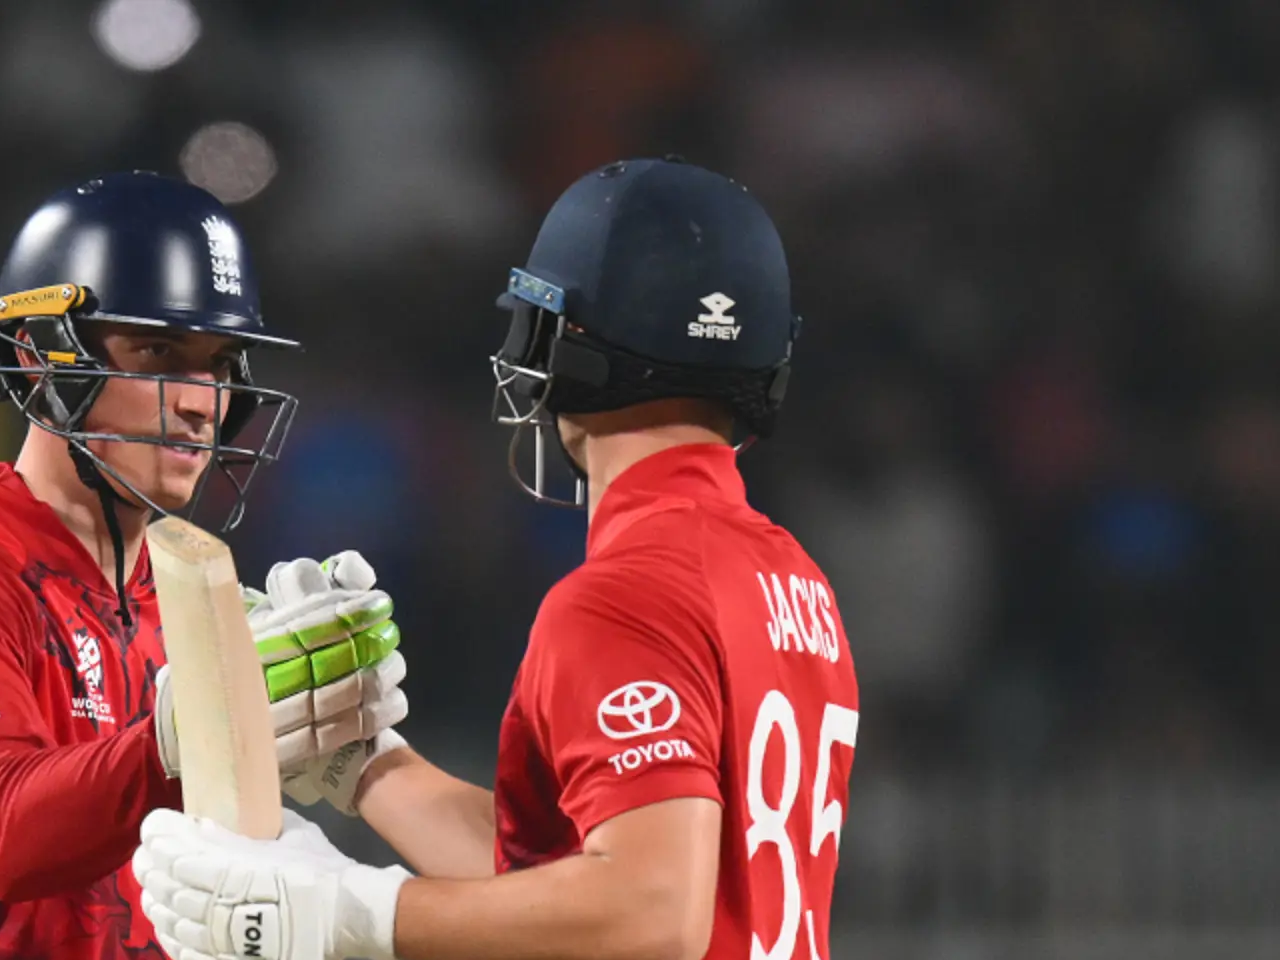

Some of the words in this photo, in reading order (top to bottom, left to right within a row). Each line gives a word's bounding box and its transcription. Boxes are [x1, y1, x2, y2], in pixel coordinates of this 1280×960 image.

[687, 322, 742, 341] SHREY
[756, 571, 839, 663] JACKS
[608, 739, 696, 776] TOYOTA
[244, 912, 262, 957] TON
